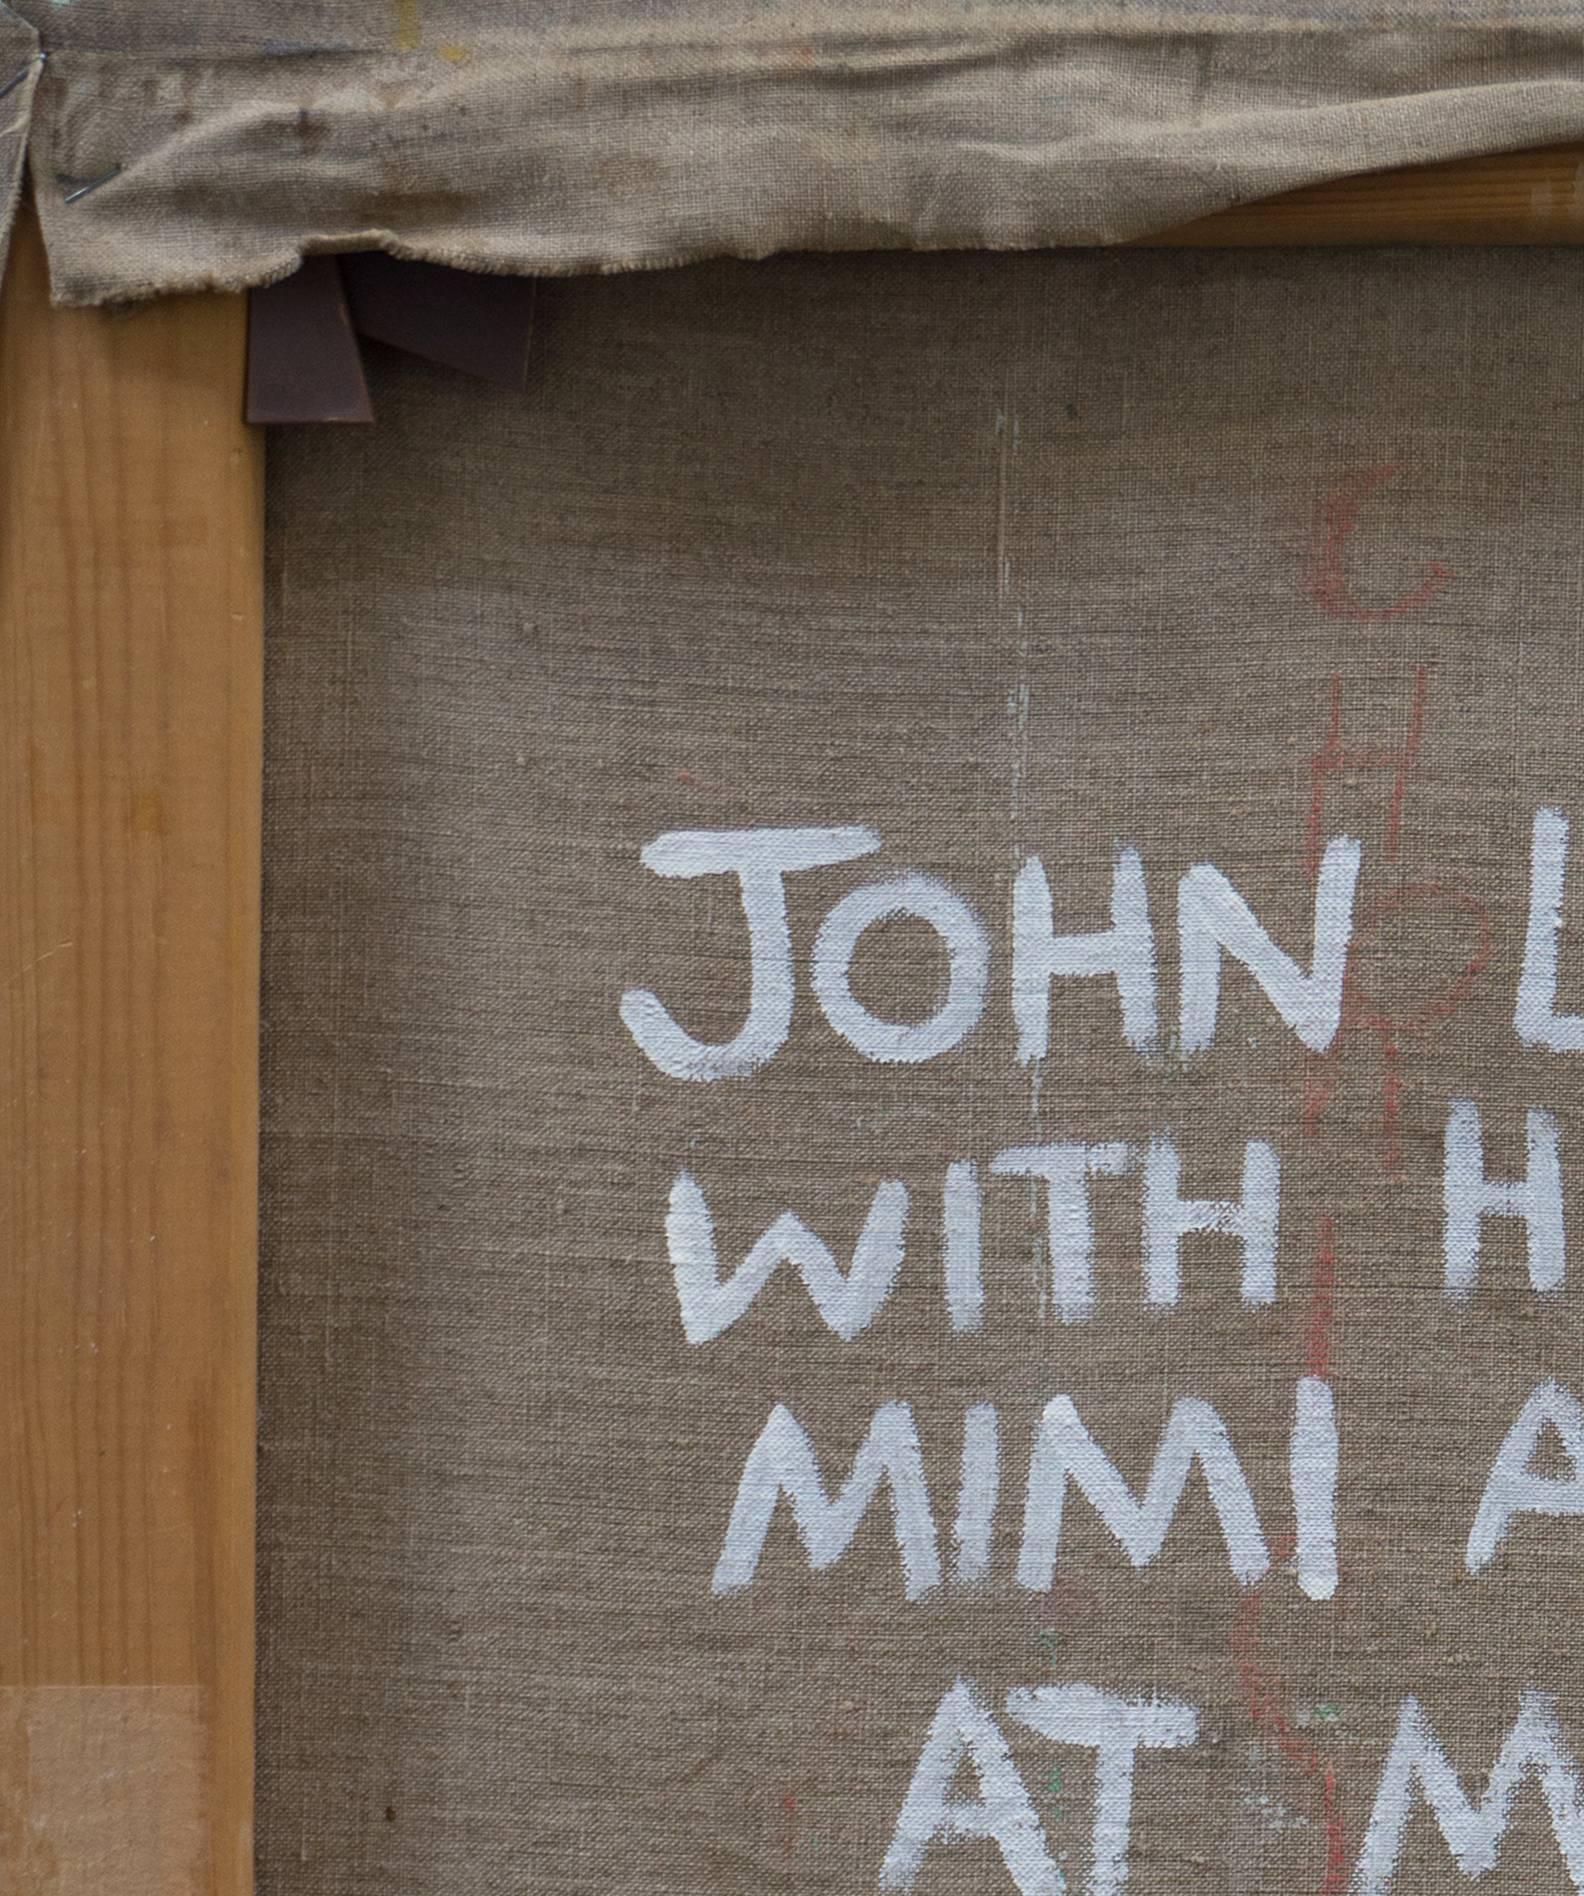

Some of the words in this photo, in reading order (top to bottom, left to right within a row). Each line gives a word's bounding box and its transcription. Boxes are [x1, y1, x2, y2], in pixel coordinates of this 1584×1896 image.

[620, 825, 1361, 1081] JOHN
[664, 1140, 1279, 1344] WITH
[711, 1376, 1338, 1600] MIMI
